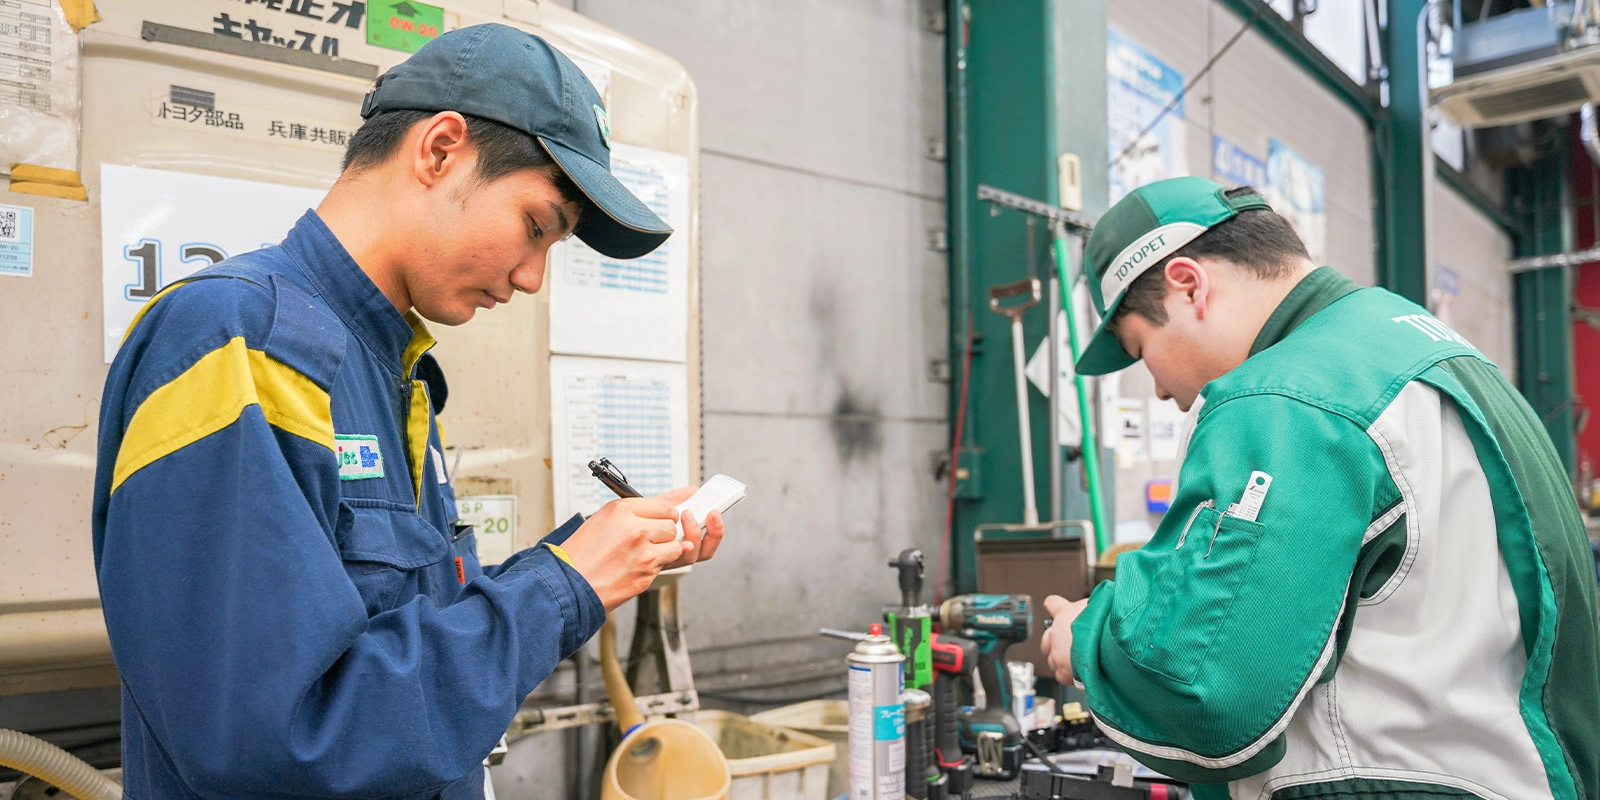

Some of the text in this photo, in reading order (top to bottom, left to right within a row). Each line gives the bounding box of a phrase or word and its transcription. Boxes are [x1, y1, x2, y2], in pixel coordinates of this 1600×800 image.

[389, 16, 438, 38] 0W-20
[158, 102, 354, 147] トヨタ部品 兵庫共販
[1114, 234, 1167, 282] TOYOPET
